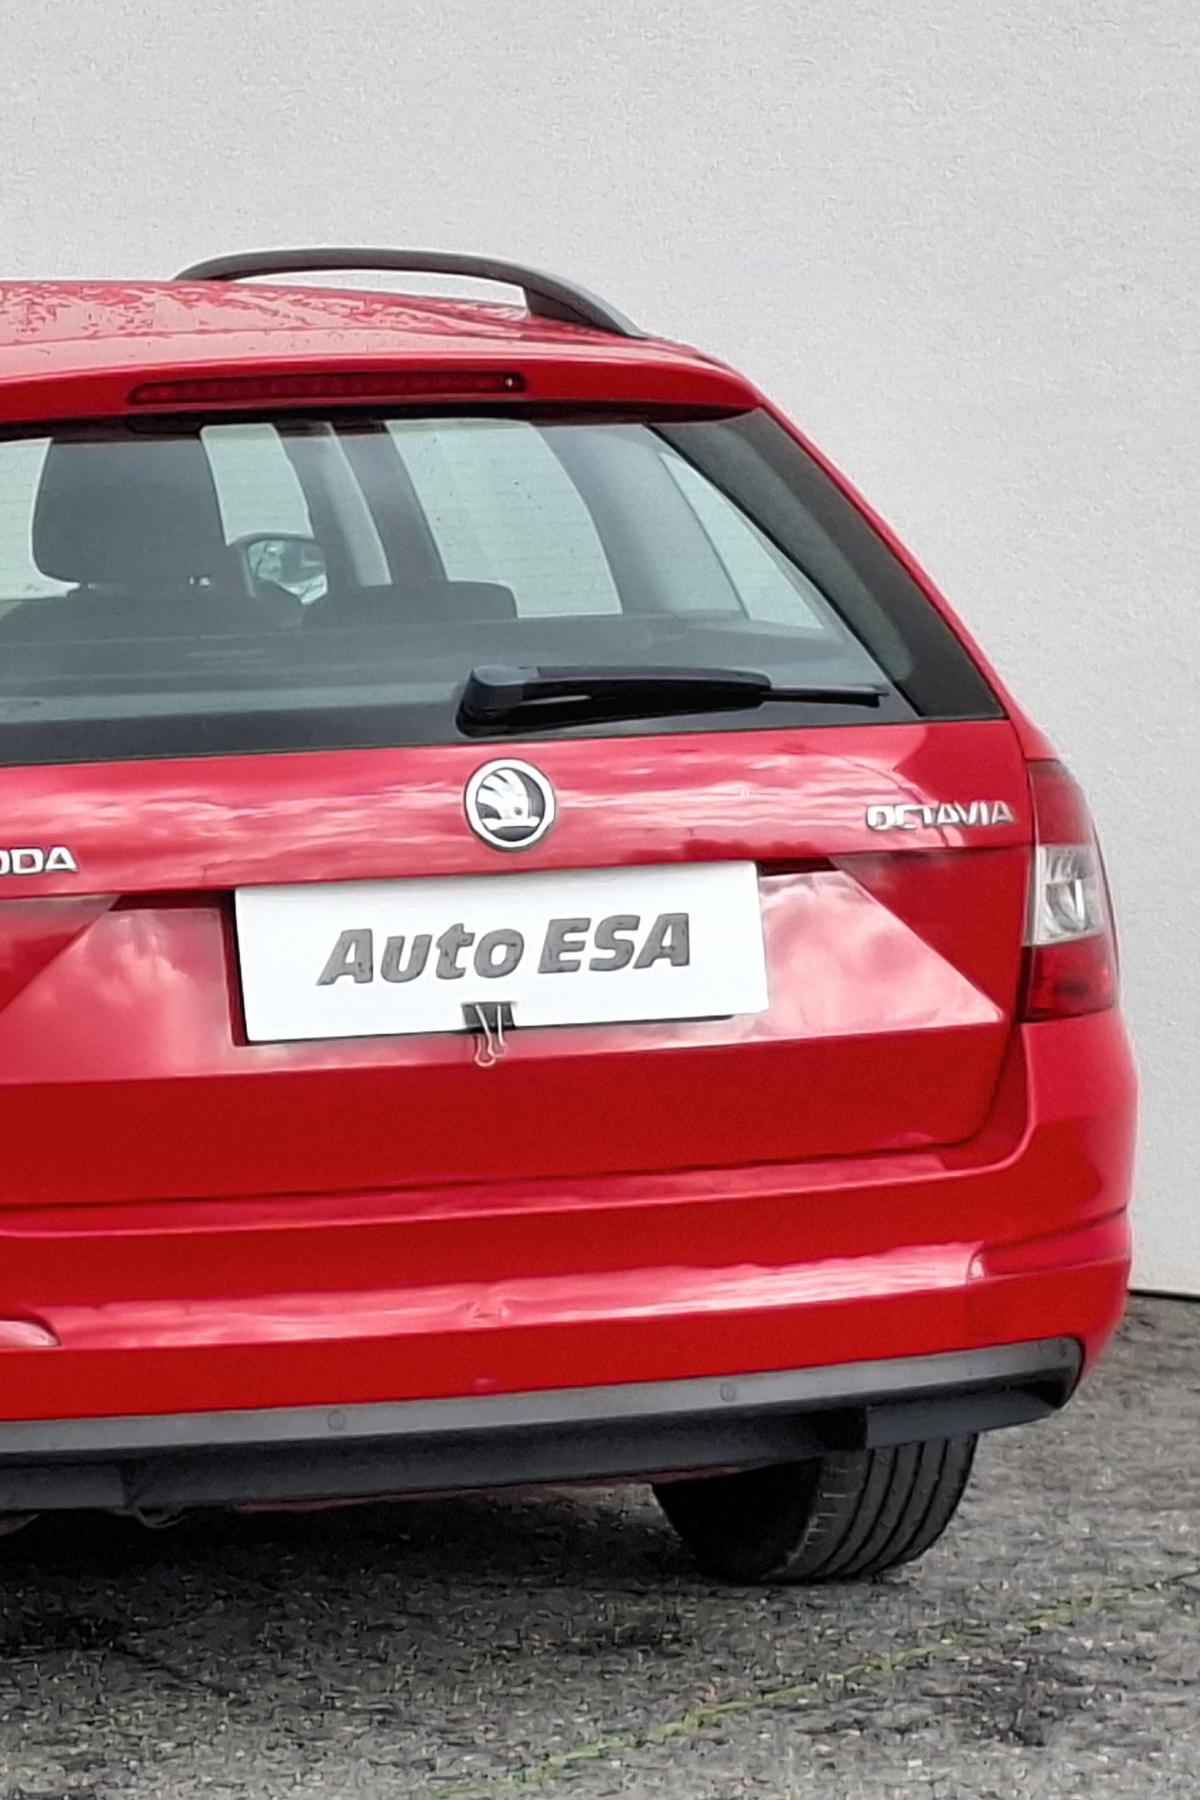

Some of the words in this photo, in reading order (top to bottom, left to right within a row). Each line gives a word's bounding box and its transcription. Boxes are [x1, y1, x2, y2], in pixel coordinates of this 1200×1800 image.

[866, 801, 1015, 831] OCTAVIA
[316, 923, 525, 986] Auto
[537, 912, 690, 974] ESA
